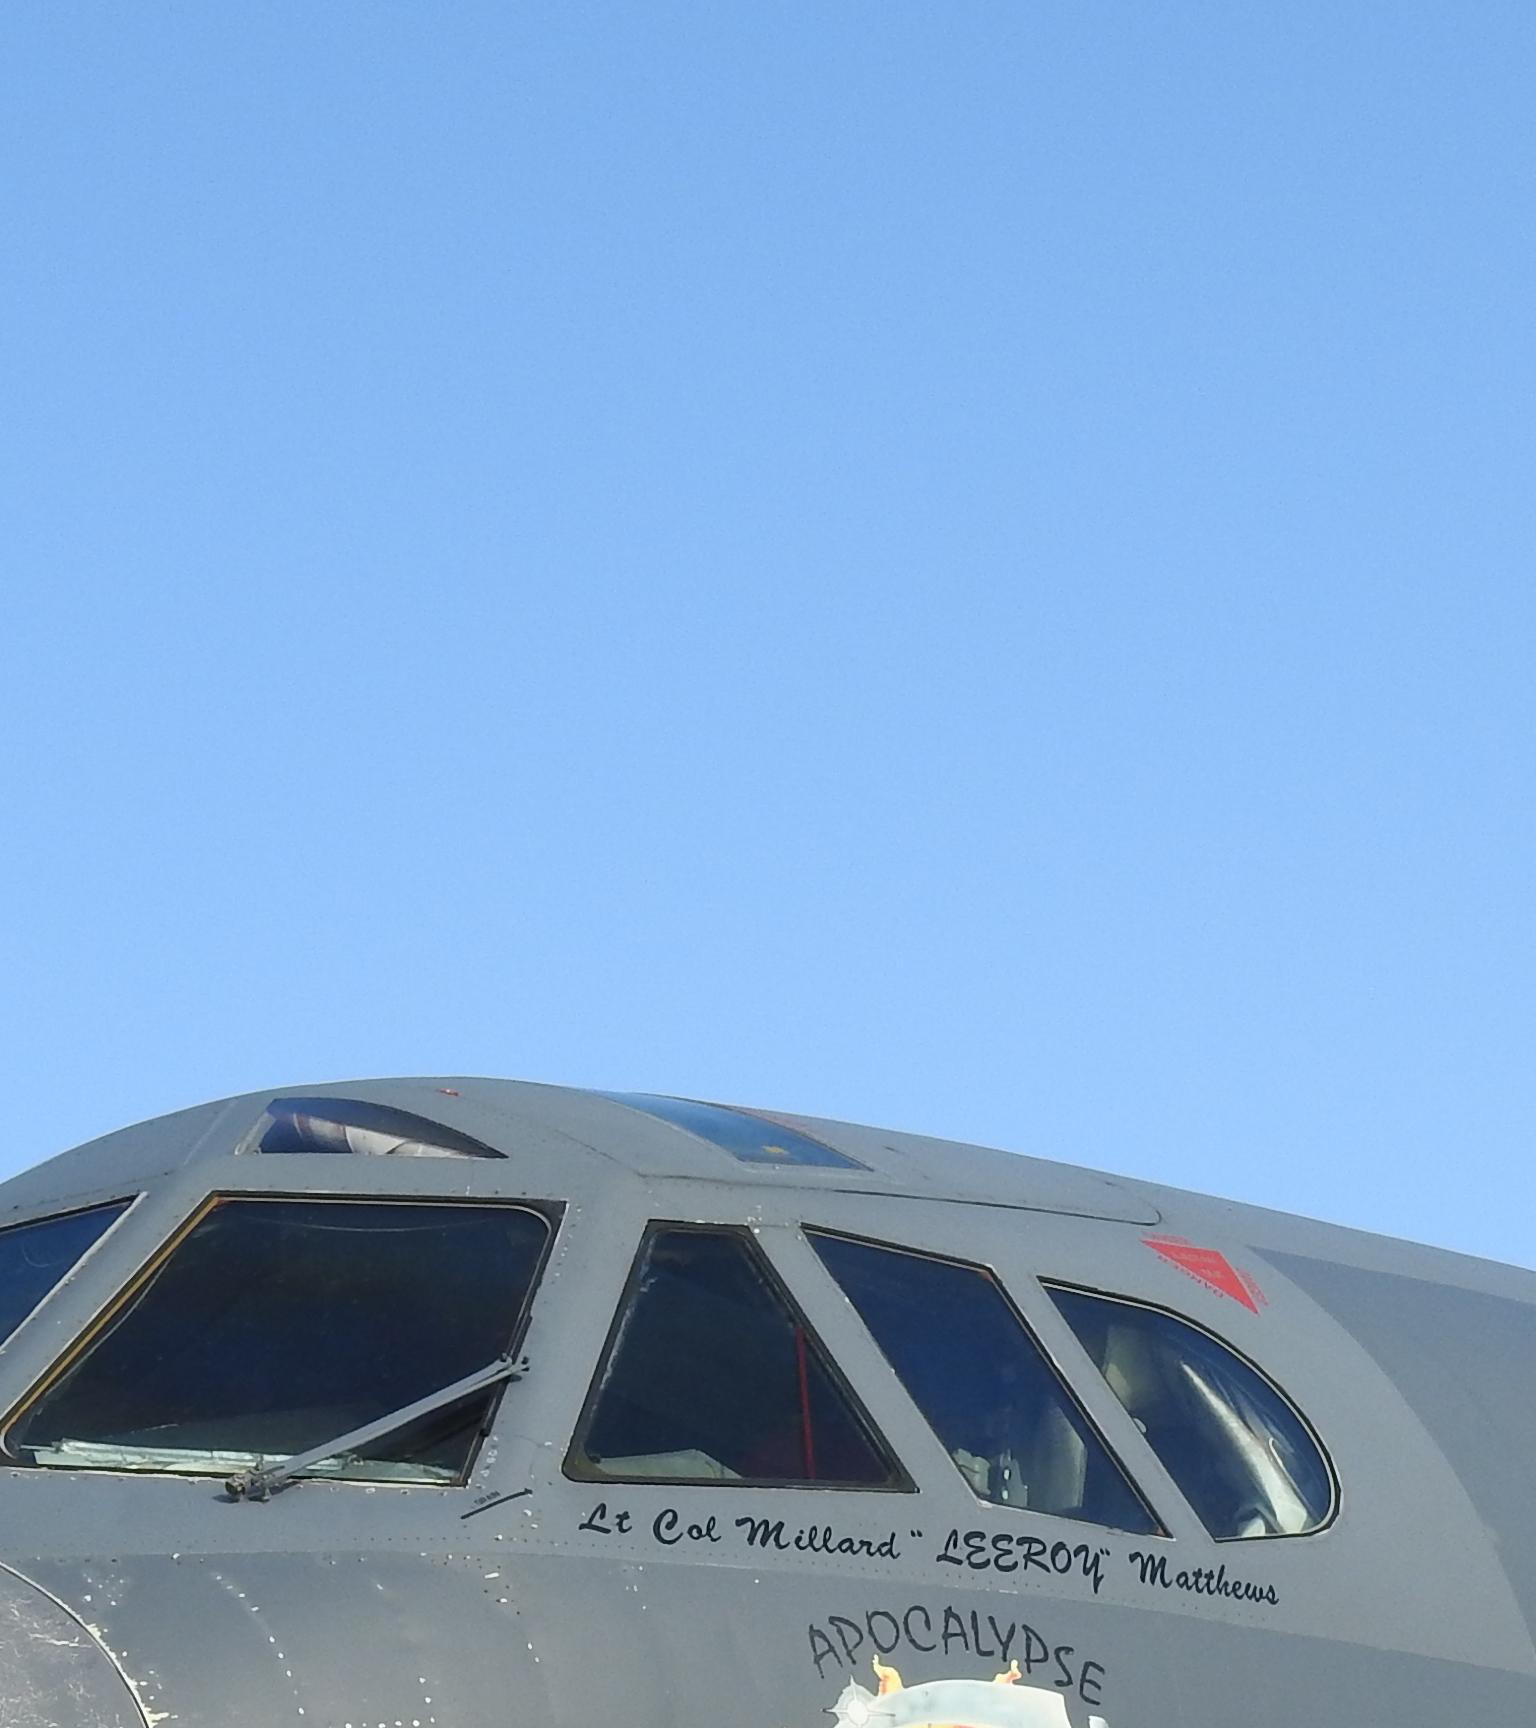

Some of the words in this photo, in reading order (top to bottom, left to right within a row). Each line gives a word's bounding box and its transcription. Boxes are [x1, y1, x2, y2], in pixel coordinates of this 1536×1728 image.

[578, 1503, 632, 1534] Lt
[653, 1508, 722, 1545] Col
[735, 1516, 901, 1559] Millard
[1128, 1551, 1279, 1605] Matthews
[807, 1609, 1106, 1706] APOCALYPSE
